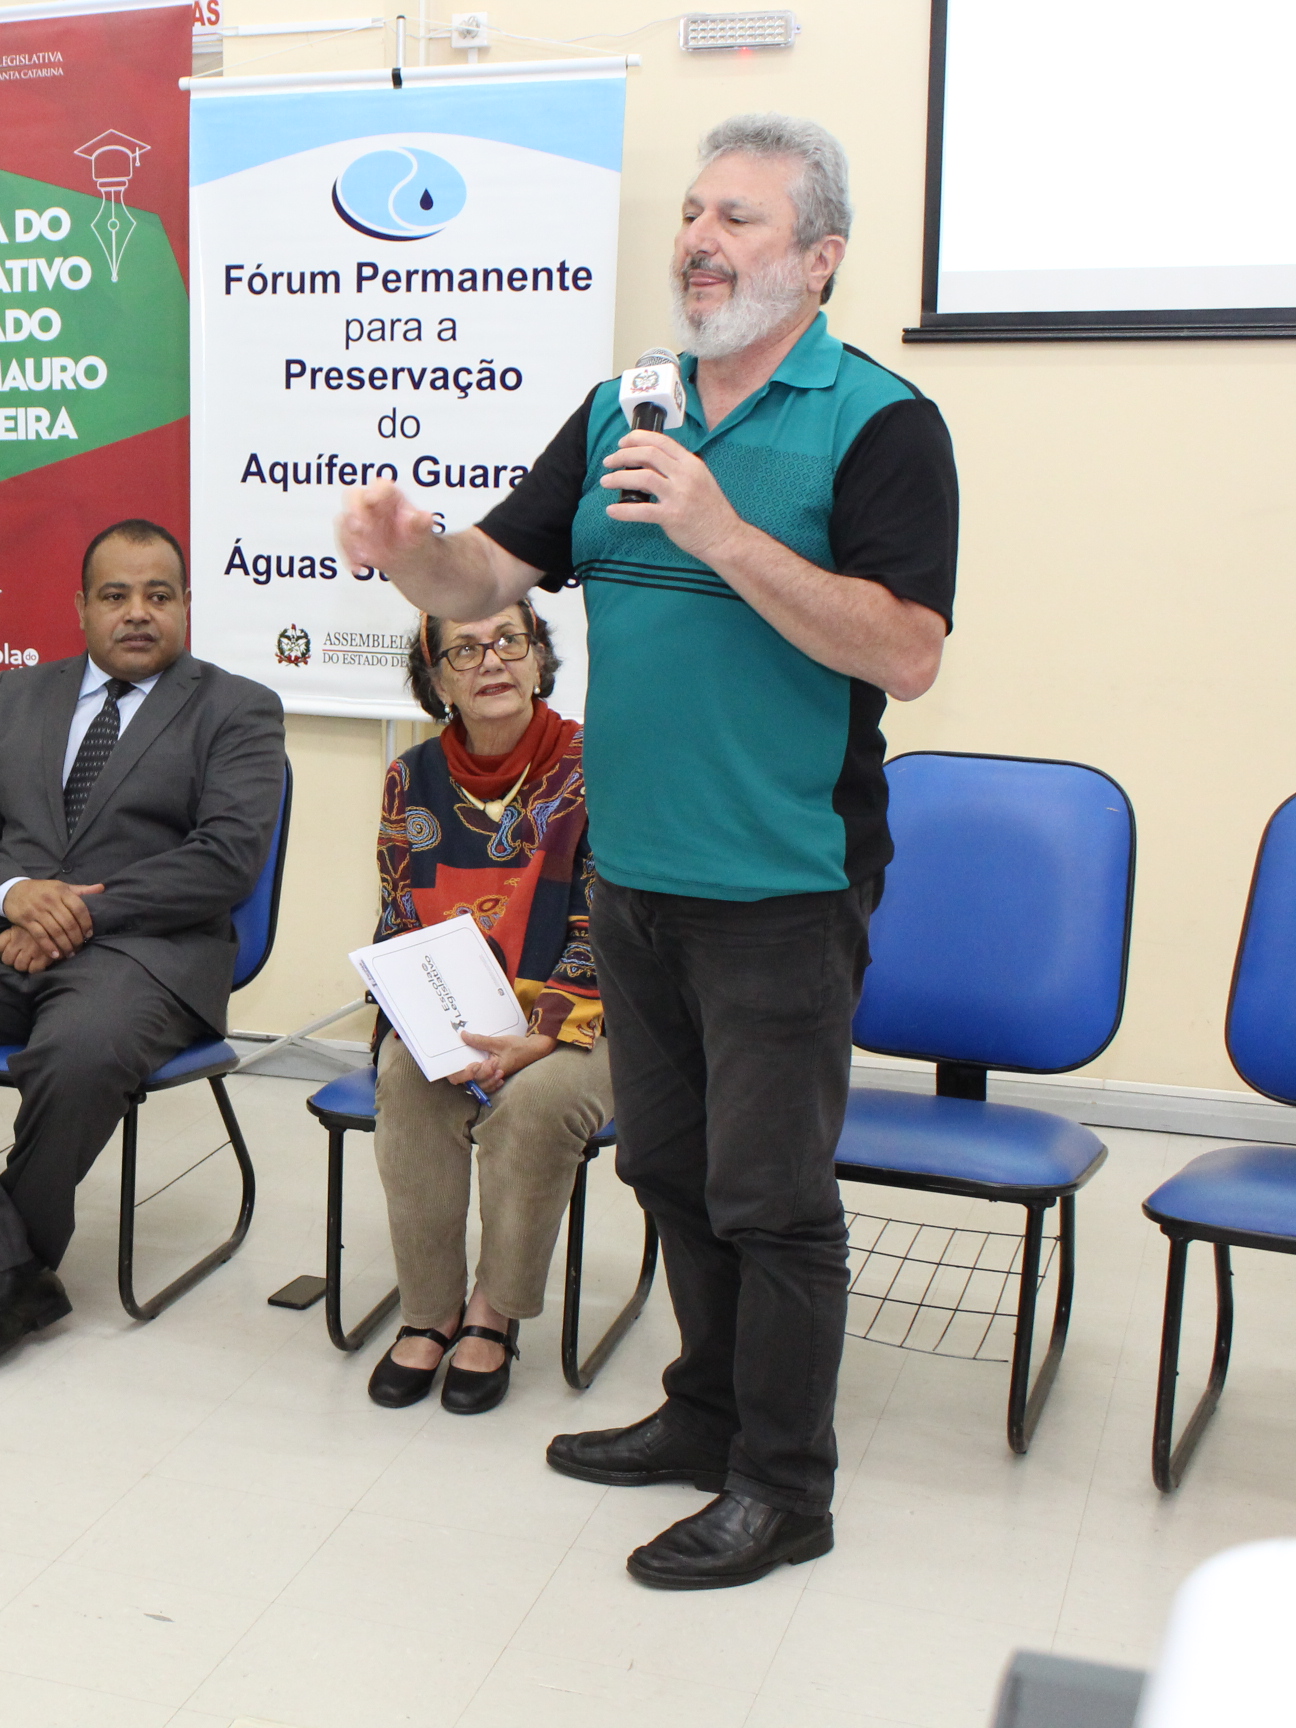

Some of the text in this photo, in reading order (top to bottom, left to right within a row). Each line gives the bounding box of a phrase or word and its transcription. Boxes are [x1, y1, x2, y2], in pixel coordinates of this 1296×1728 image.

[21, 67, 64, 79] CATARINA
[15, 207, 71, 243] DO
[224, 259, 593, 295] Fórum Permanente
[345, 317, 458, 351] para a
[284, 358, 523, 399] Preservação
[377, 407, 421, 439] do
[240, 453, 529, 492] Aquífero Guara
[224, 538, 338, 586] Águas
[25, 651, 37, 661] do
[322, 652, 409, 668] DO ESTADO DE
[425, 955, 461, 1018] Legislativo
[426, 972, 450, 1011] Escola
